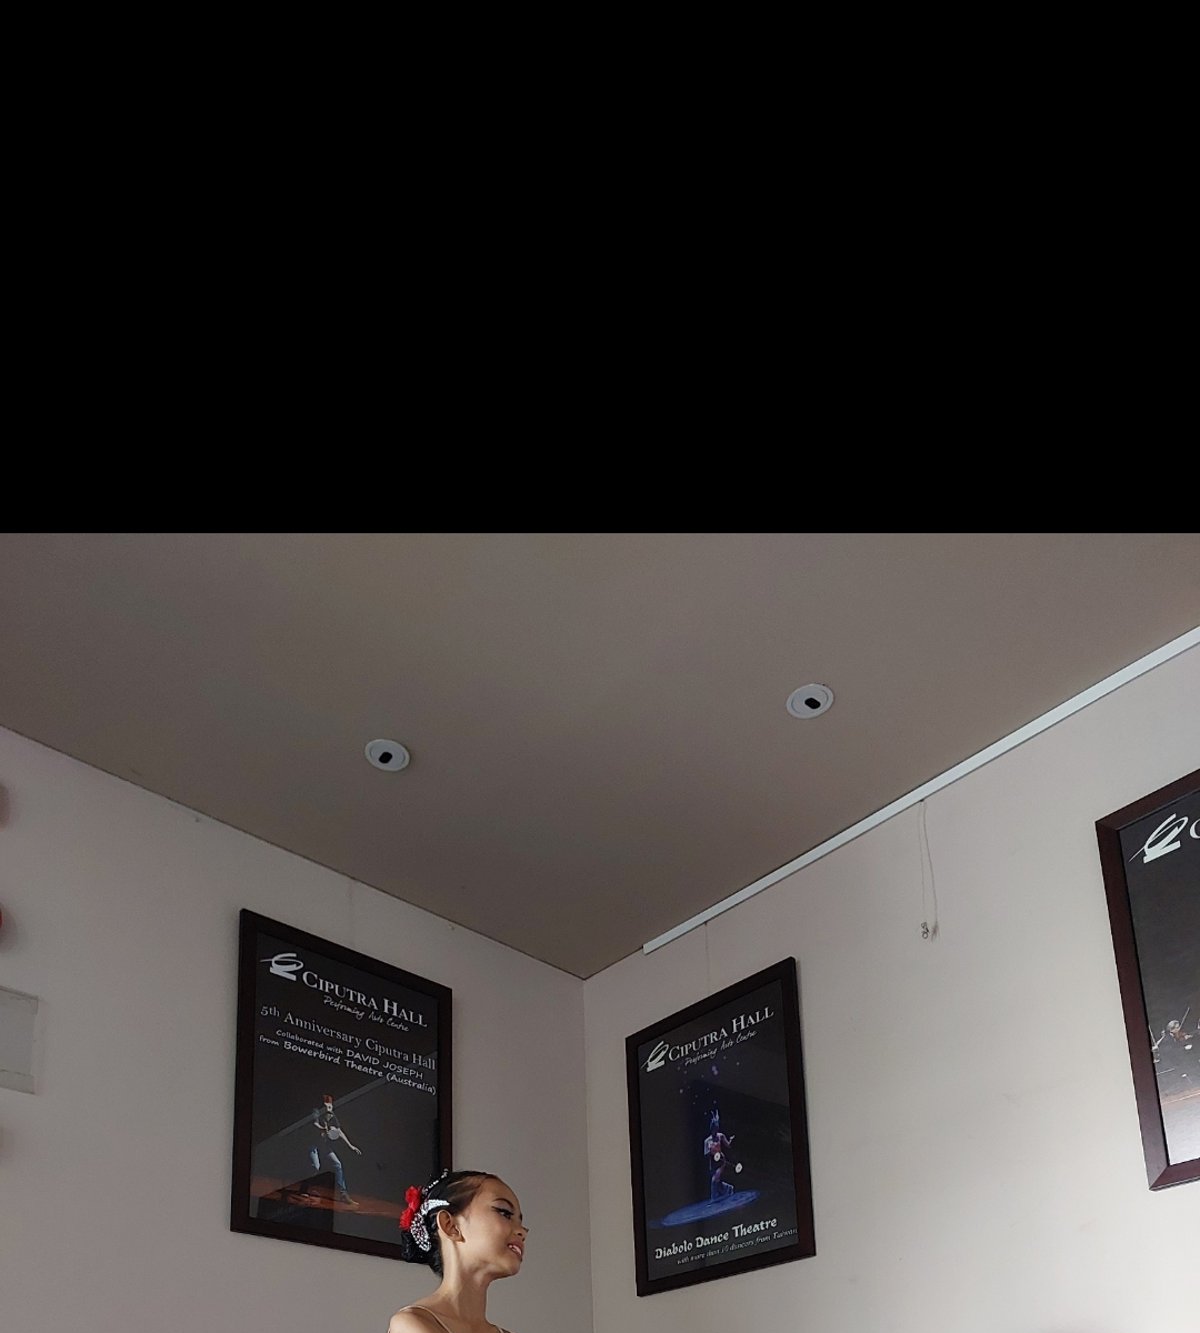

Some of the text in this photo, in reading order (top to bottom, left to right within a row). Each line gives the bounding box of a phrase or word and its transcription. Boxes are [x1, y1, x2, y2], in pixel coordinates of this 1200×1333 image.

[302, 971, 428, 1028] CIPUTRA HALL
[260, 1005, 436, 1070] 5th Anniversary Ciputra Hall
[276, 1029, 423, 1080] Collaborated with DAVID JOSEPH
[668, 1006, 775, 1062] CIPUTRA HALL
[259, 1034, 437, 1096] from Bowerbird Theatre (Australia)
[654, 1218, 778, 1260] Diabolo Dance Theatre
